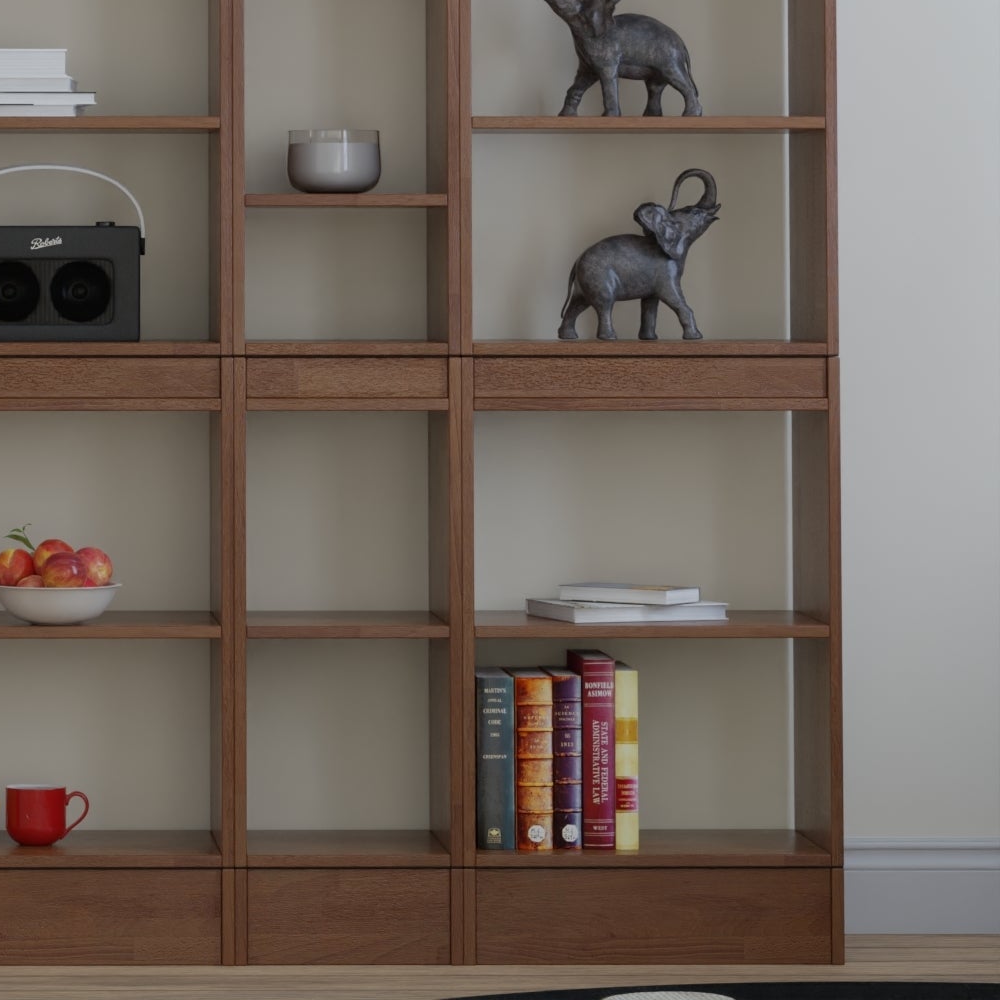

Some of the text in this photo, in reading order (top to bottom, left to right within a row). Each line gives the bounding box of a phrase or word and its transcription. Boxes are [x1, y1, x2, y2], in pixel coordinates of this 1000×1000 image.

[30, 236, 62, 250] Roberts
[587, 689, 612, 697] ASIMOW
[592, 719, 600, 805] ADMINISTRATIVE LAW
[600, 721, 609, 804] STATE AND FEDERAL
